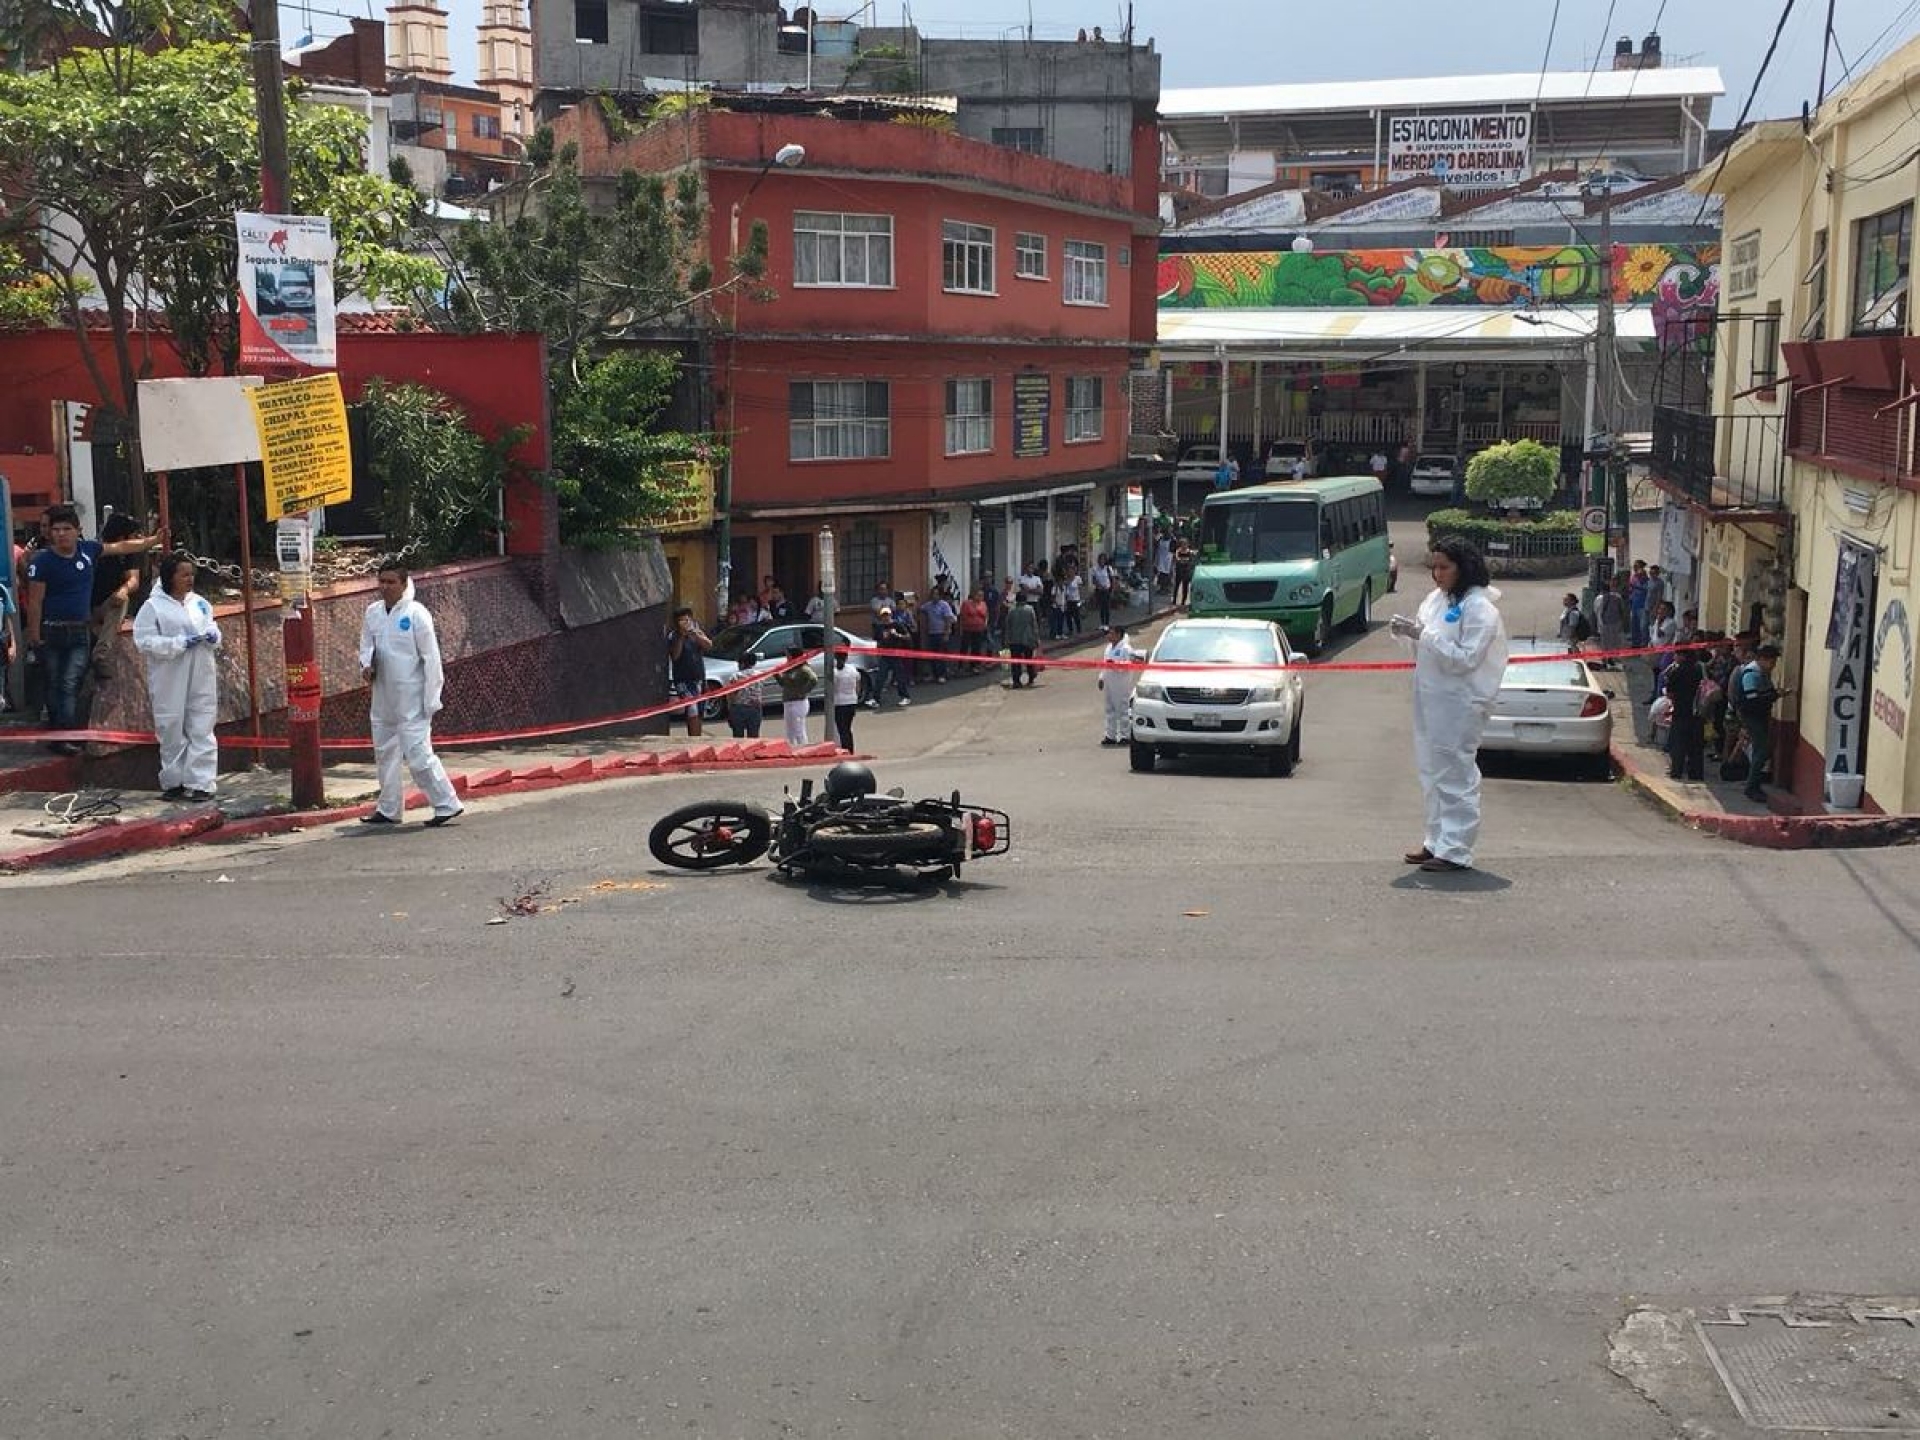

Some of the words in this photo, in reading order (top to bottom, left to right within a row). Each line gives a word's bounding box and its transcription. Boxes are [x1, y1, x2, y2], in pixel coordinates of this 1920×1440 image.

[1393, 116, 1526, 142] ESTACIONAMIENTO
[1415, 143, 1464, 151] SUPERIOR
[1459, 150, 1526, 169] CAROLINA
[245, 255, 277, 265] Seguro
[257, 393, 311, 410] HUATULCO
[263, 410, 307, 426] CHIAPAS
